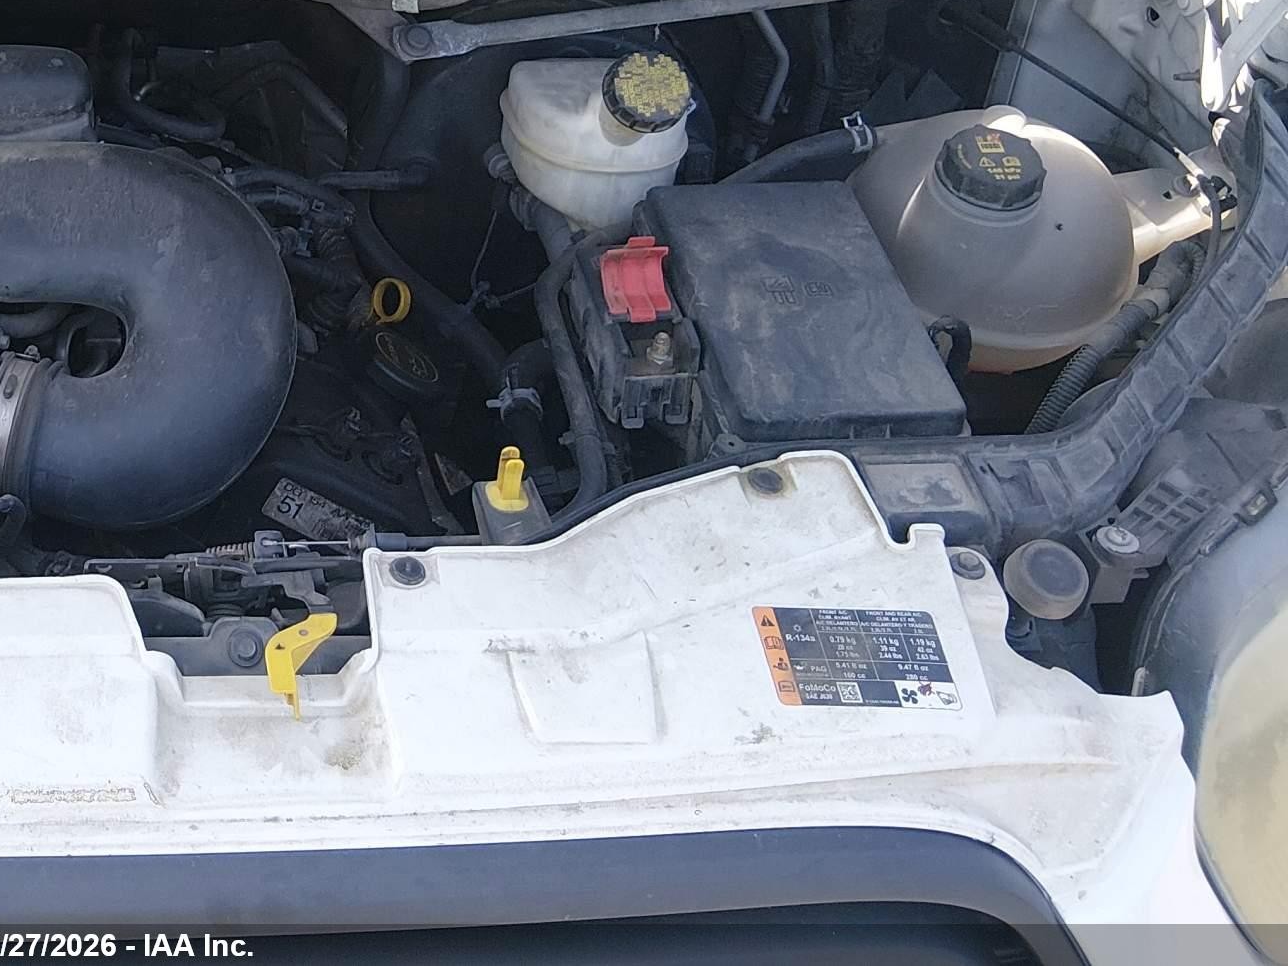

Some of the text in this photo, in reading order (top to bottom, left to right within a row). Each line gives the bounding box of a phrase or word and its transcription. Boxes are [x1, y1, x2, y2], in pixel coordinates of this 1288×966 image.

[277, 495, 304, 519] 51
[785, 634, 816, 642] R-134a
[798, 683, 836, 692] FoMoCo
